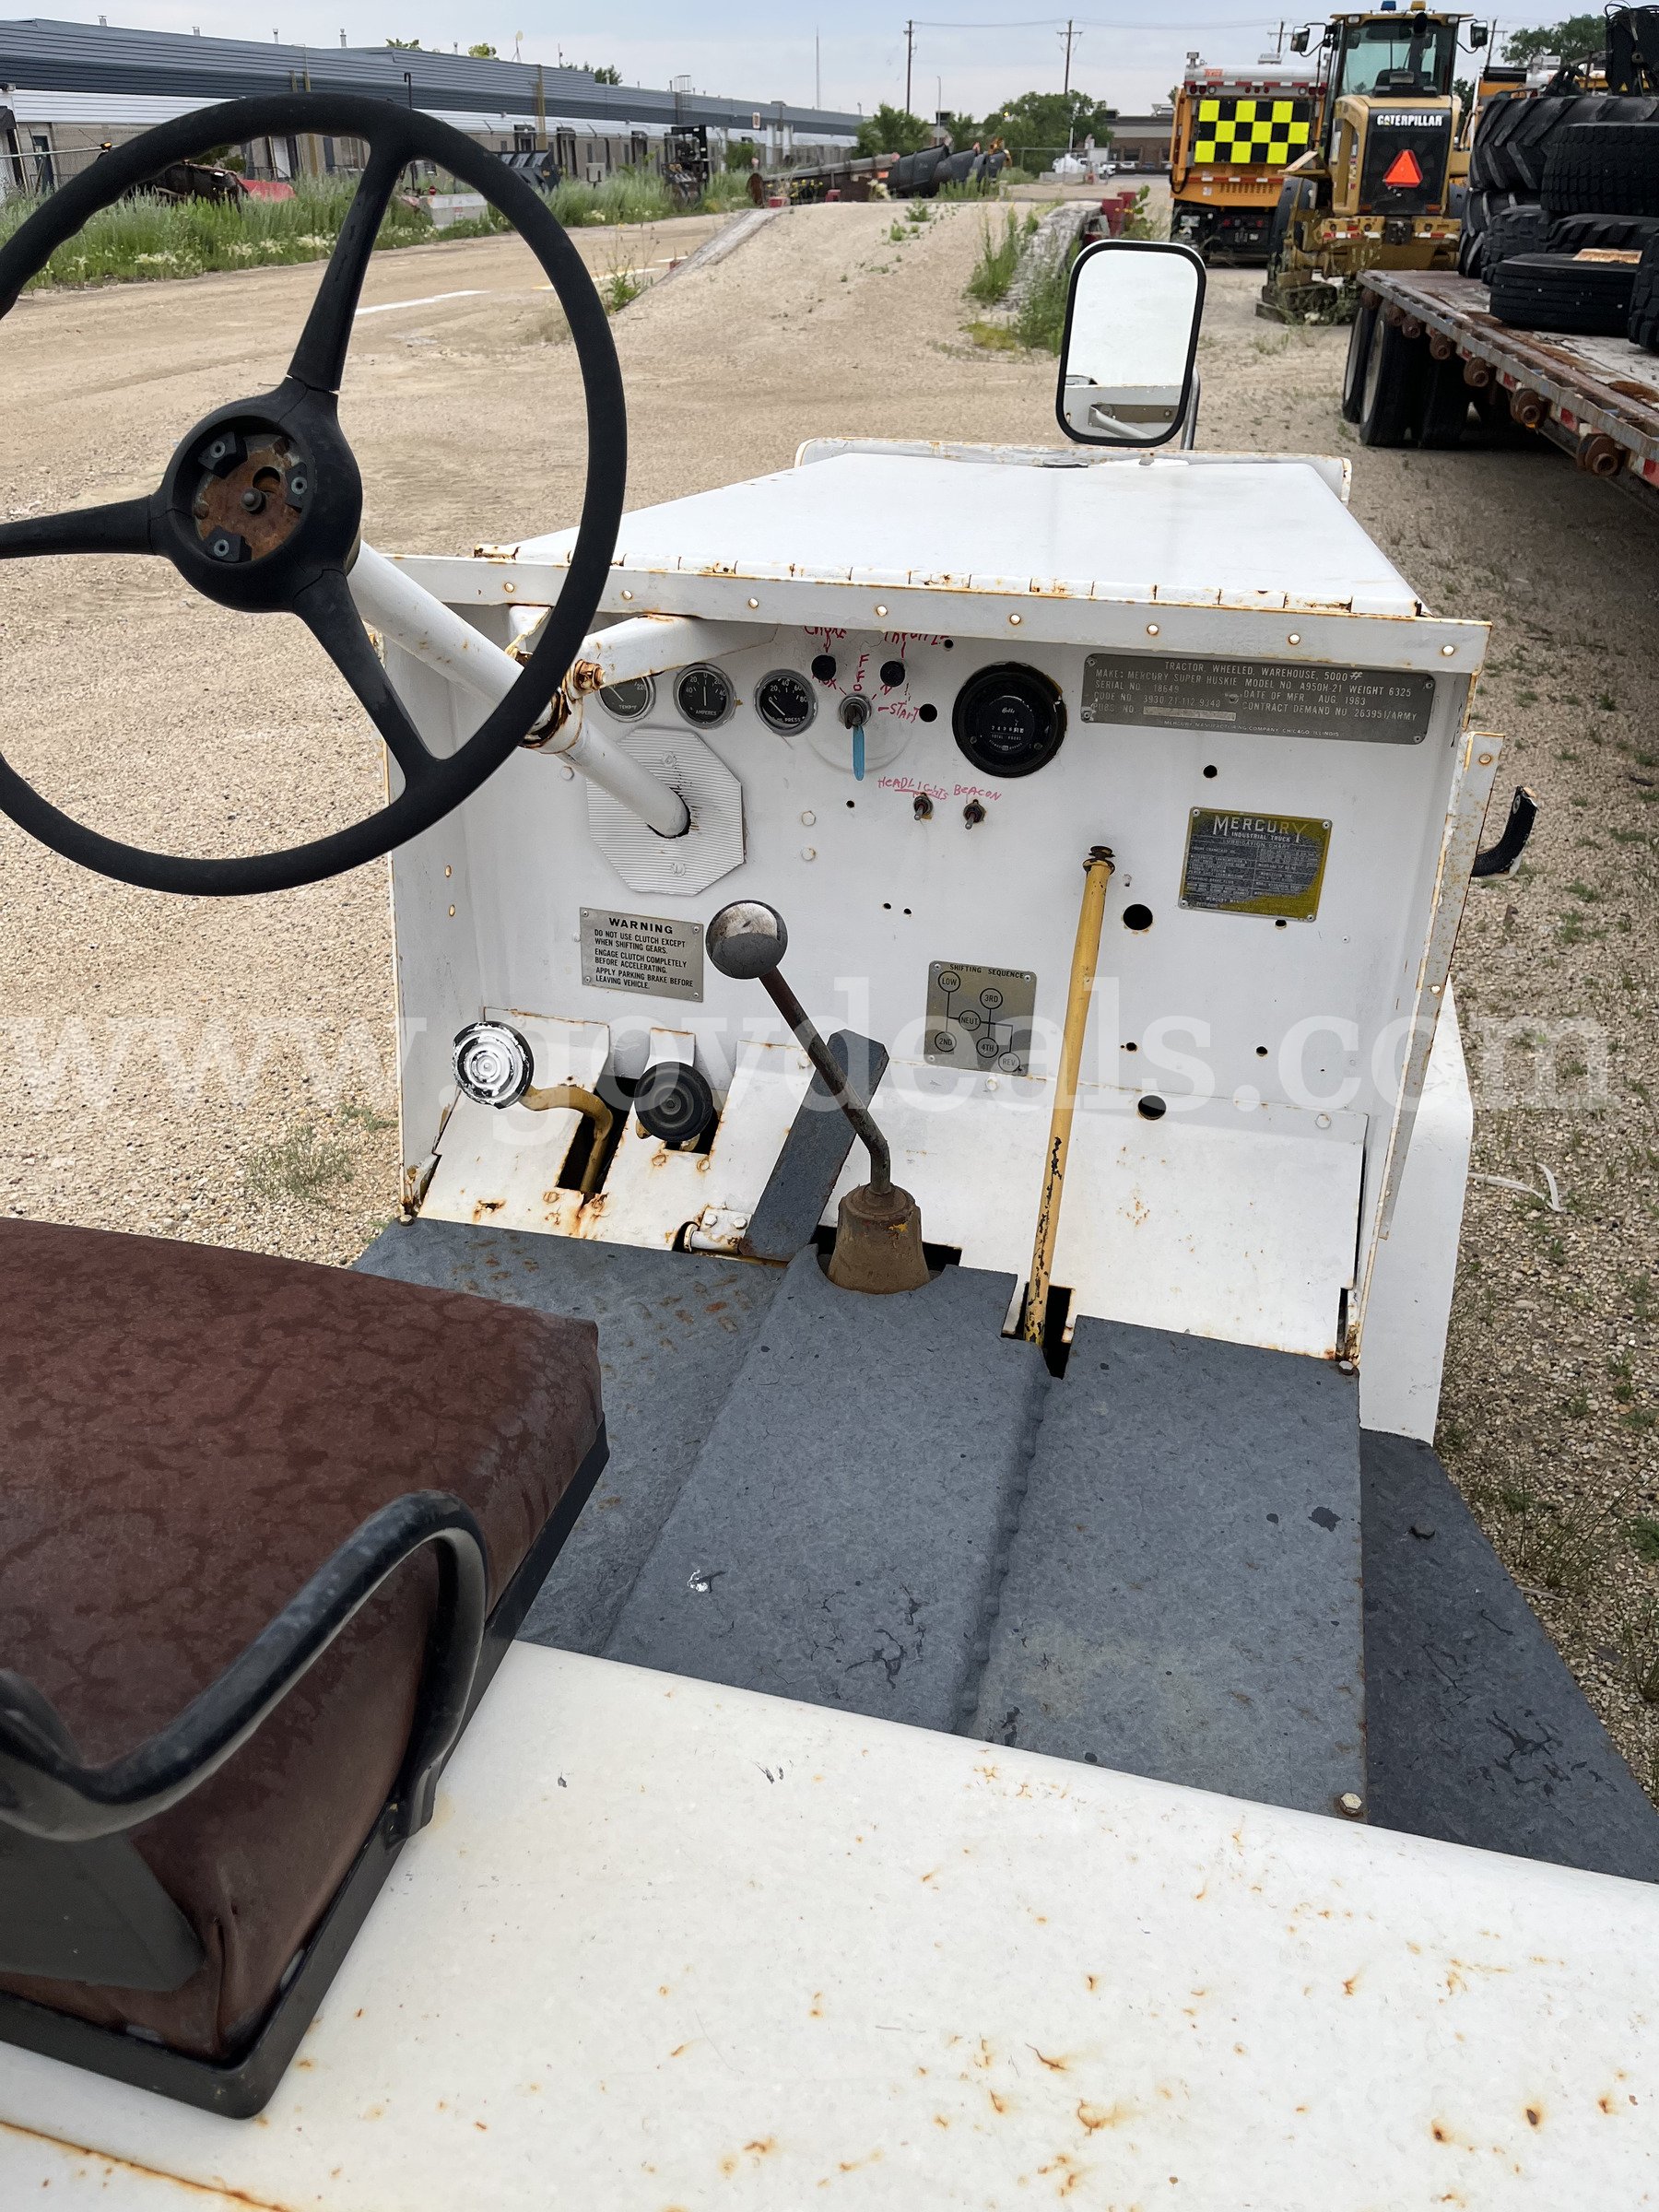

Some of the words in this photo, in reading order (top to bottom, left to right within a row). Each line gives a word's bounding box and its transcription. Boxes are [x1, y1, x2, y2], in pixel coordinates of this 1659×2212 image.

[1377, 115, 1442, 126] CATERPILLAR
[1261, 667, 1319, 681] WAREHOUSE,
[1095, 680, 1124, 690] SERIAL
[1096, 669, 1124, 678] MAKE:
[1127, 671, 1169, 682] MERCURY
[1173, 674, 1202, 684] SUPER
[1206, 676, 1238, 686] HUSKIE
[1245, 678, 1274, 688] MODEL
[1349, 685, 1384, 695] WEIGHT
[1388, 688, 1412, 697] 6325
[1093, 691, 1115, 701] CODE
[1244, 689, 1265, 700] DATE
[1271, 691, 1281, 700] OF
[1242, 701, 1288, 712] CONTRACT
[1293, 704, 1331, 715] DEMAND
[1212, 815, 1310, 844] MERCURY
[1231, 831, 1268, 841] INDUSTRIAL
[1271, 834, 1291, 843] TRUCK
[609, 917, 674, 935] WARNING
[594, 928, 603, 936] DO
[605, 929, 618, 938] NOT
[619, 932, 632, 941] USE
[634, 934, 659, 945] CLUTCH
[661, 937, 686, 948] EXCEPT
[594, 937, 613, 947] WHEN
[615, 941, 643, 951] SHIFTING
[645, 945, 668, 955] GEARS.
[594, 947, 618, 959] ENGAGE
[620, 950, 645, 962] CLUTCH
[646, 954, 688, 969] COMPLETELY
[594, 956, 618, 967] BEFORE
[620, 960, 668, 974] ACCELERATING.
[595, 966, 616, 976] APPLY
[618, 970, 645, 981] PARKING
[647, 973, 667, 984] BRAKE
[670, 977, 694, 988] BEFORE
[949, 963, 982, 974] SHIFTING
[988, 968, 1024, 979] SEQUENCE
[595, 974, 621, 985] LEAVING
[623, 978, 651, 990] VEHICLE.
[941, 978, 958, 986] LOW
[983, 994, 999, 1003] 3RD
[938, 1037, 953, 1046] 2ND
[981, 1043, 994, 1052] 4TH
